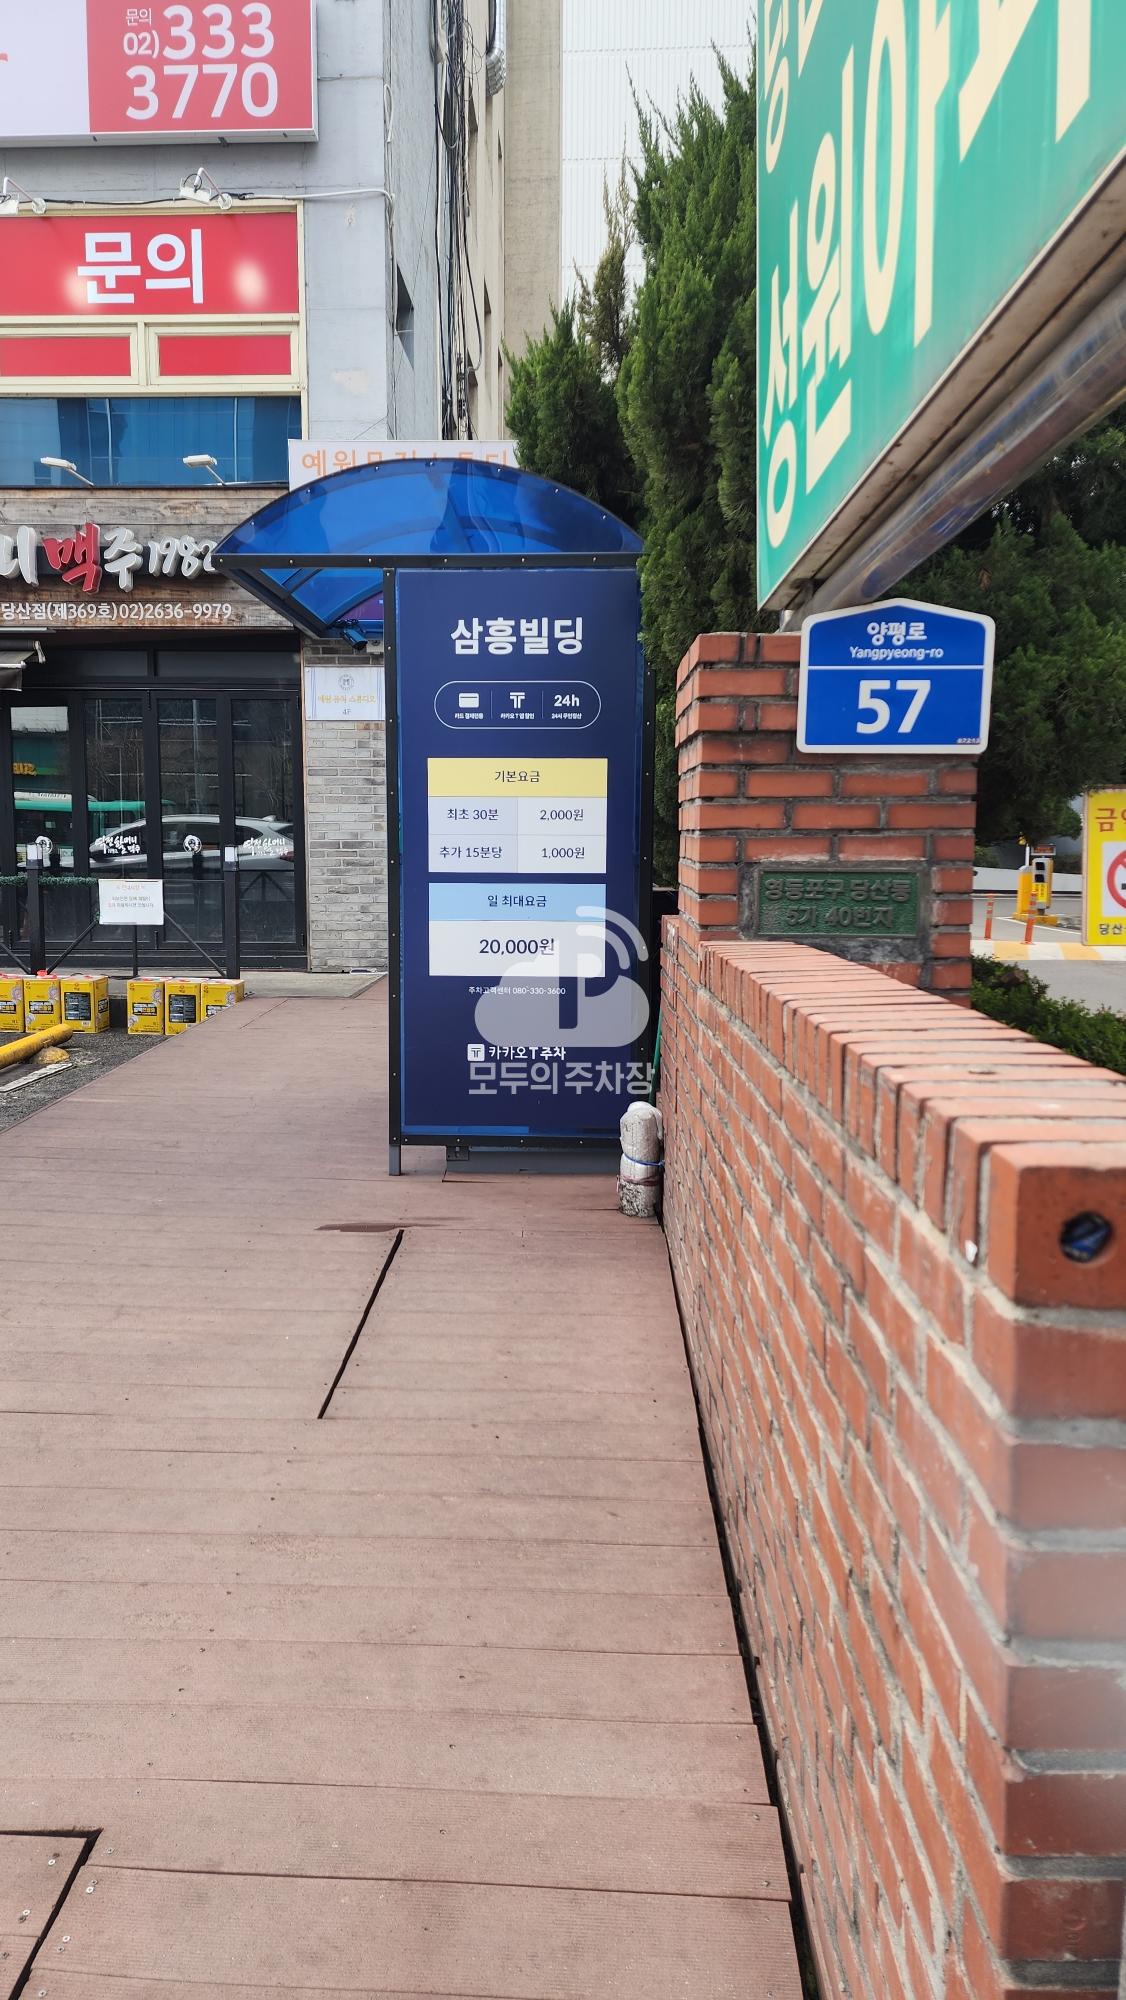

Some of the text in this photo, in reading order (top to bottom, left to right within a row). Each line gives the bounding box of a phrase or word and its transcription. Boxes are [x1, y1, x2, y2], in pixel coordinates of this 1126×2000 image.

[125, 8, 152, 26] 문의
[126, 62, 278, 120] 3770
[77, 229, 204, 304] 문의
[450, 617, 583, 655] 삼흥빌딩
[866, 622, 927, 646] 양평로
[849, 646, 944, 660] Yangpyeong-ro
[554, 694, 580, 707] 24h
[856, 680, 931, 734] 57
[494, 770, 541, 783] 기본요금
[447, 808, 584, 821] 최초 30분 2,000원
[1095, 807, 1126, 832] 금
[439, 846, 585, 859] 추가 15분당 1,000원
[764, 878, 912, 902] 영등포구 당산동
[487, 895, 547, 907] 일 최대요금
[825, 906, 894, 928] 40번지
[1098, 923, 1126, 935] 당산
[479, 938, 555, 956] 20,000원
[468, 986, 566, 995] 주차고객센터 080-330-3600
